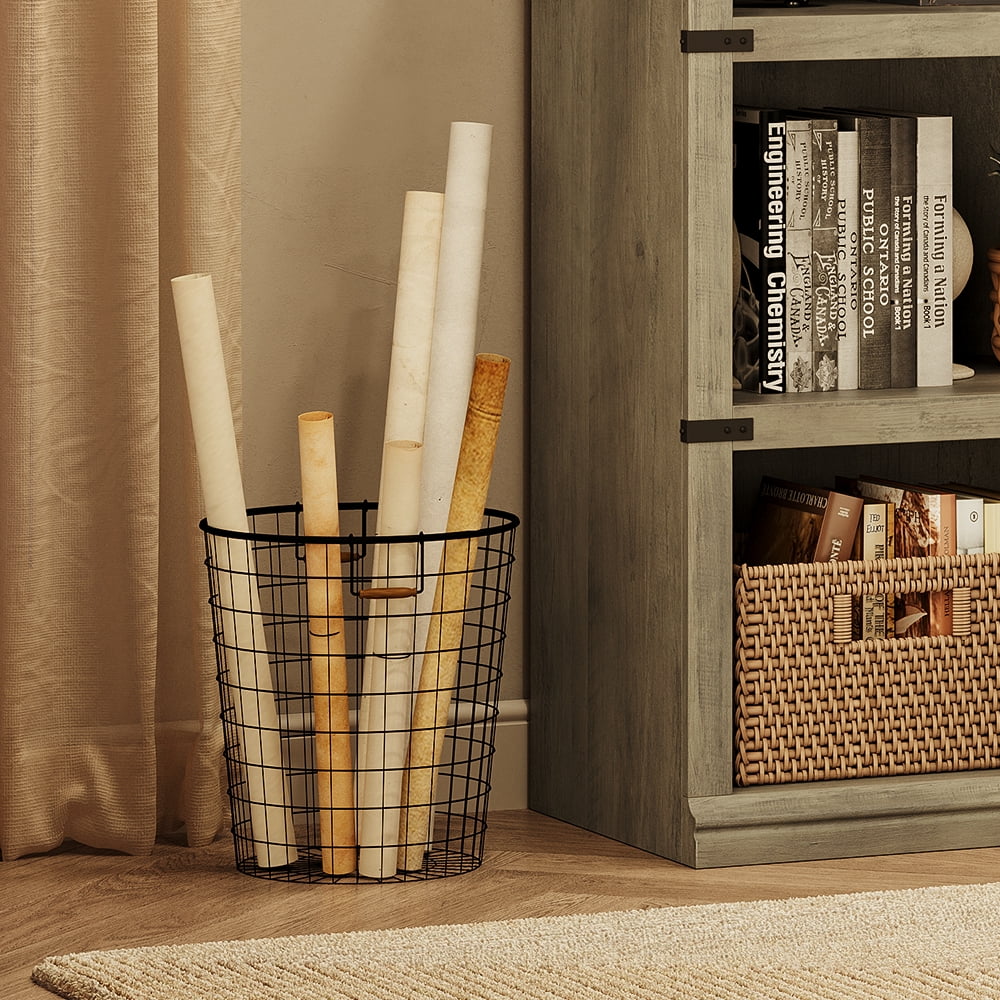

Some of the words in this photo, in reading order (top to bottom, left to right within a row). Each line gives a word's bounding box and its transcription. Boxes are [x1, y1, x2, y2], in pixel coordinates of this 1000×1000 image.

[799, 141, 810, 178] PUBLIC
[825, 141, 836, 177] PUBLIC
[763, 121, 786, 259] Engineering
[795, 160, 803, 202] HISTORY
[799, 181, 810, 221] SCHOOL
[820, 159, 828, 202] HISTORY
[824, 180, 836, 220] SCHOOL
[837, 199, 846, 261] PUBLIC
[862, 188, 874, 254] PUBLIC
[900, 195, 913, 262] Forming
[922, 206, 930, 221] Story
[931, 195, 947, 260] Forming
[879, 223, 889, 306] ONTARIO
[902, 266, 911, 275] a
[935, 265, 944, 274] a
[787, 251, 812, 321] ENGLAND
[802, 323, 810, 333] &
[813, 250, 837, 321] ENGLAND
[828, 322, 836, 332] &
[837, 273, 846, 342] SCHOOL
[862, 266, 874, 339] SCHOOL
[902, 278, 913, 330] Nation
[934, 277, 947, 328] Nation
[762, 271, 786, 392] Chemistry
[894, 306, 902, 322] Book
[923, 305, 931, 323] Book
[789, 489, 828, 509] CHARLOTTE
[869, 513, 881, 522] TED
[875, 593, 885, 609] OF
[875, 610, 885, 637] THE
